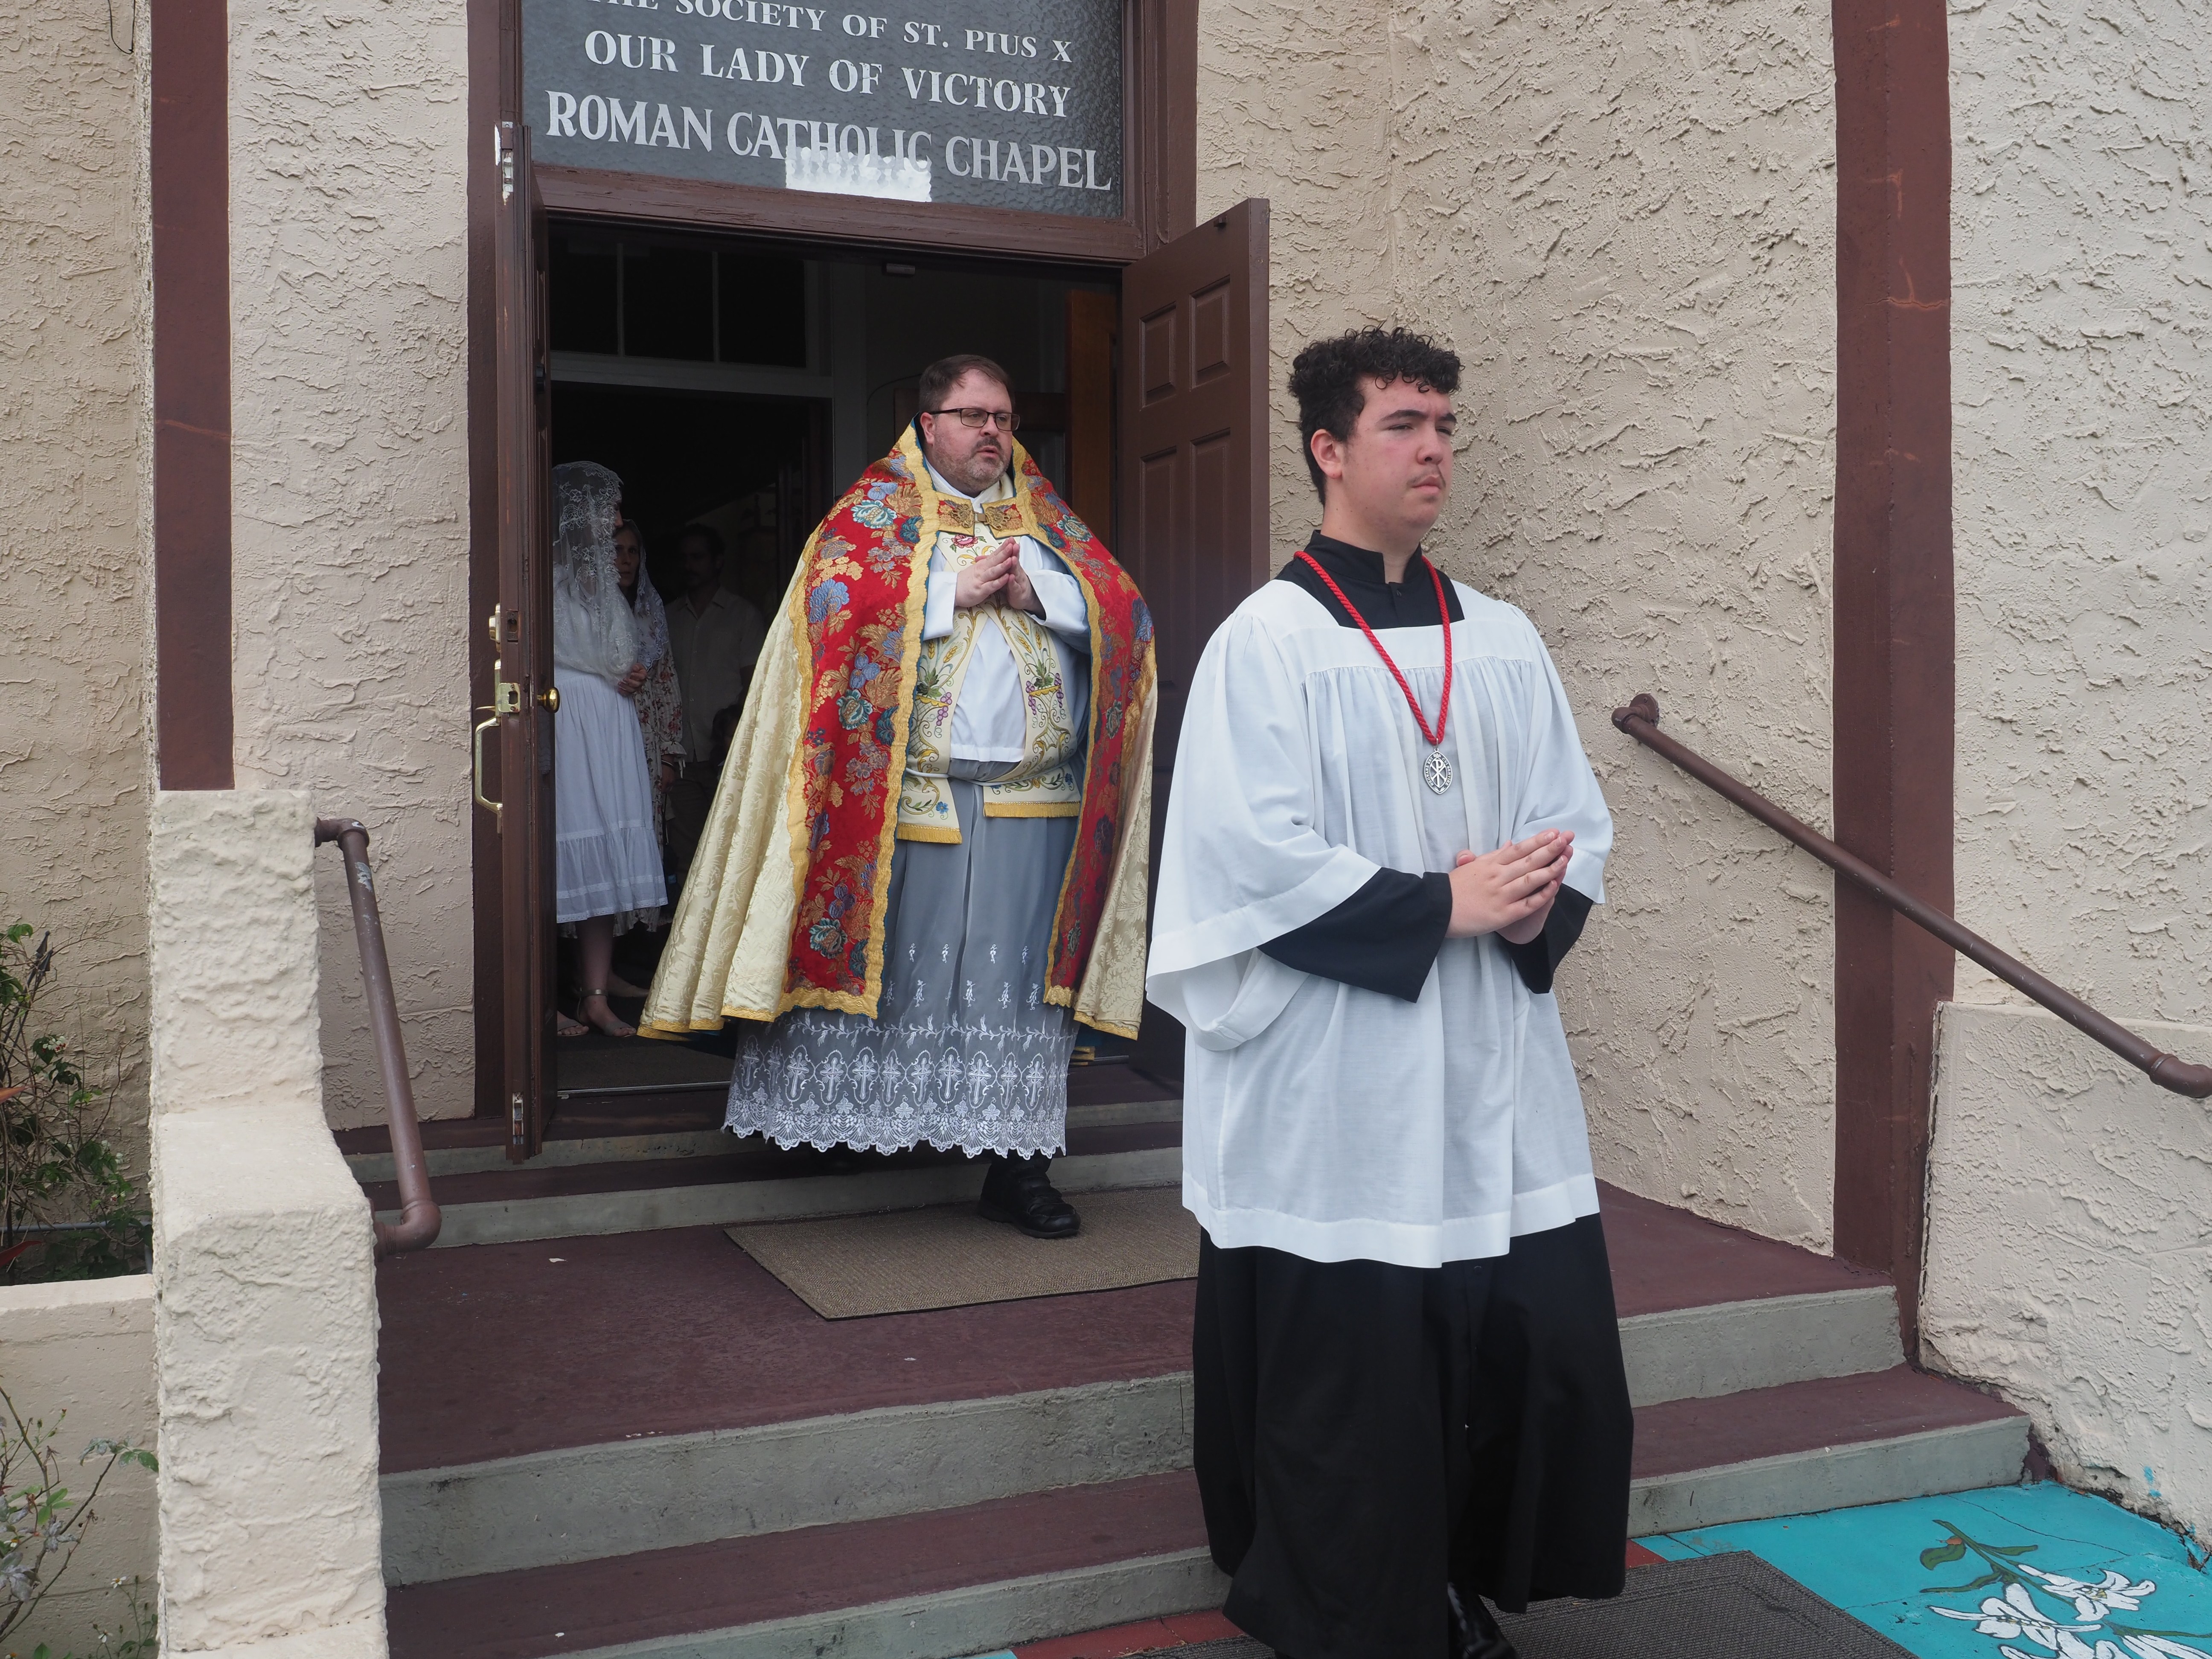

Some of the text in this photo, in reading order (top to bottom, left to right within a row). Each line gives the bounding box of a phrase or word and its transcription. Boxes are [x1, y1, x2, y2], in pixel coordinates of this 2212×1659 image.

[585, 30, 1071, 117] OUR LADY OF VICTORY
[676, 0, 1072, 63] SOCIETY OF ST. PIUS X
[544, 90, 1112, 191] ROMAN CATHOLIC CHAPEL
